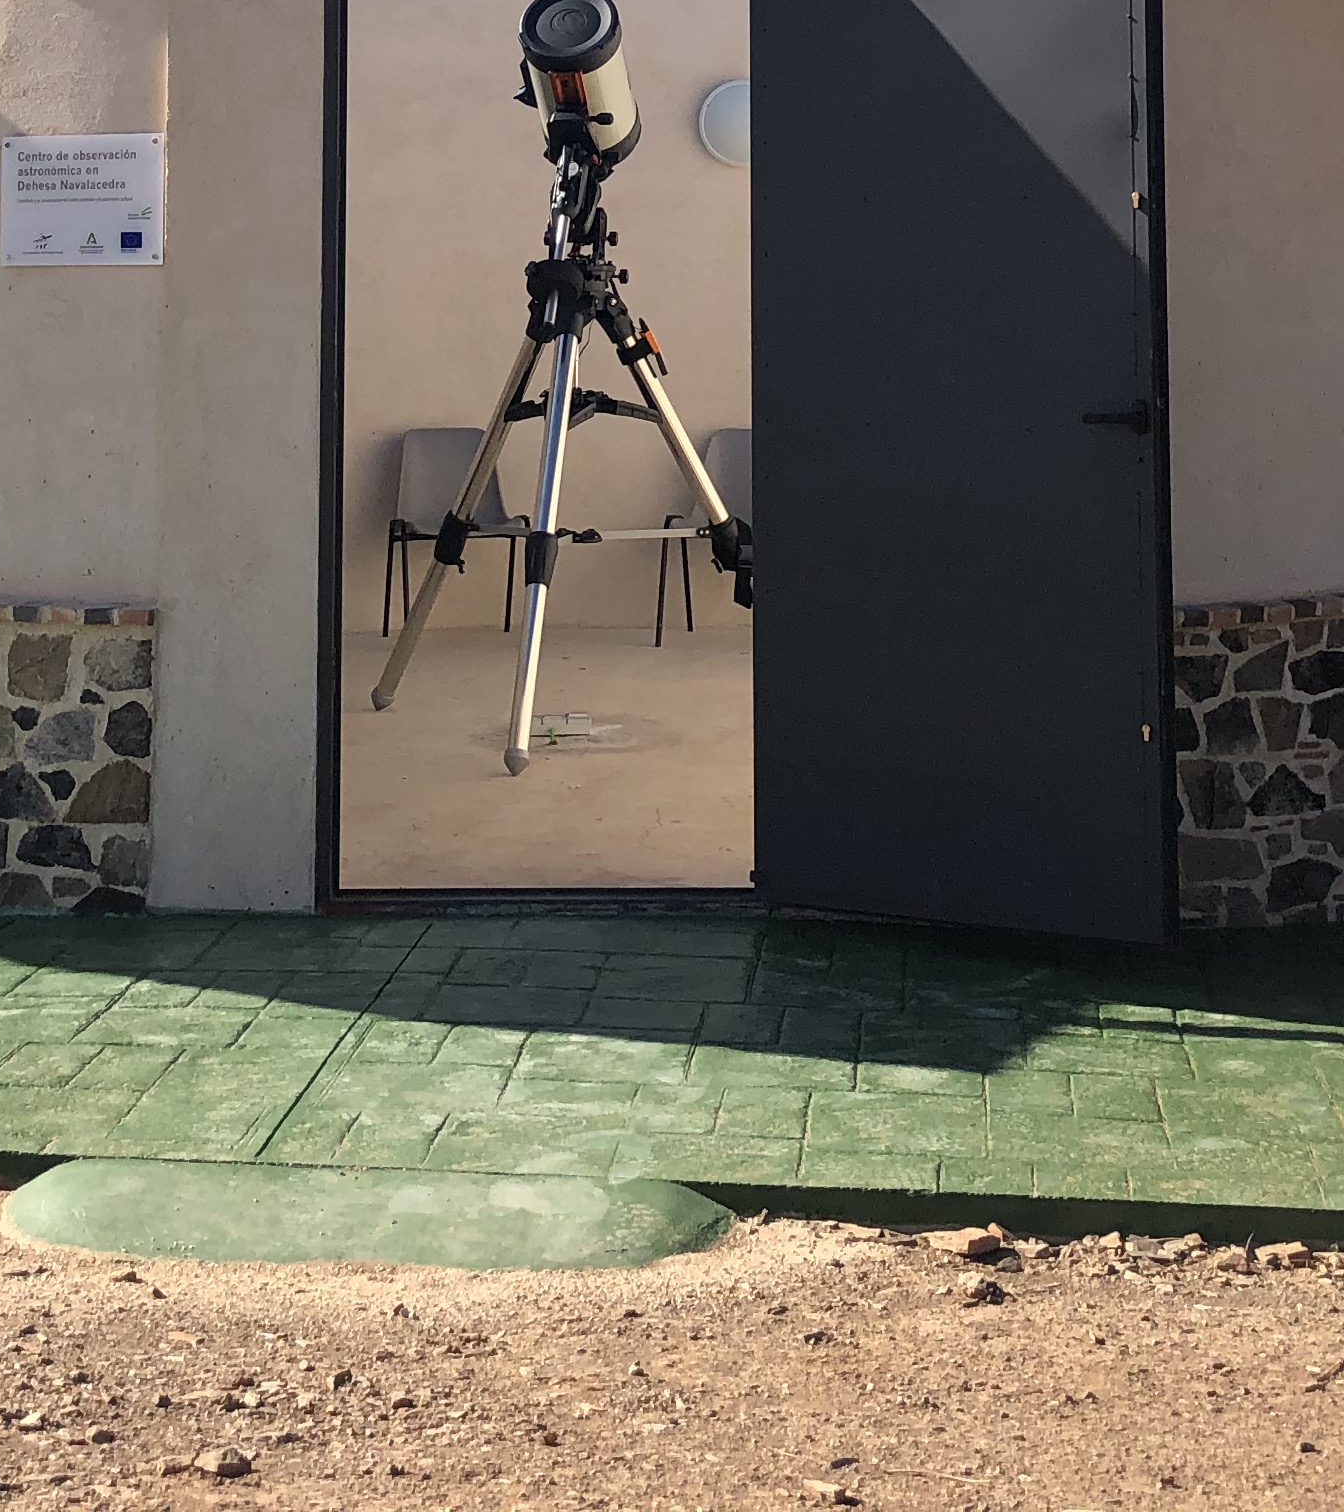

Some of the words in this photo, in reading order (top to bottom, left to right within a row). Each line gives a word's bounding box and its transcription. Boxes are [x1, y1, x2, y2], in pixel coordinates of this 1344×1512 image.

[17, 151, 53, 162] Centro
[56, 150, 69, 161] de
[72, 149, 137, 161] observación
[17, 164, 82, 177] astronómica
[85, 166, 99, 175] en
[17, 180, 57, 191] Dehesa
[60, 179, 126, 191] Navalacedra
